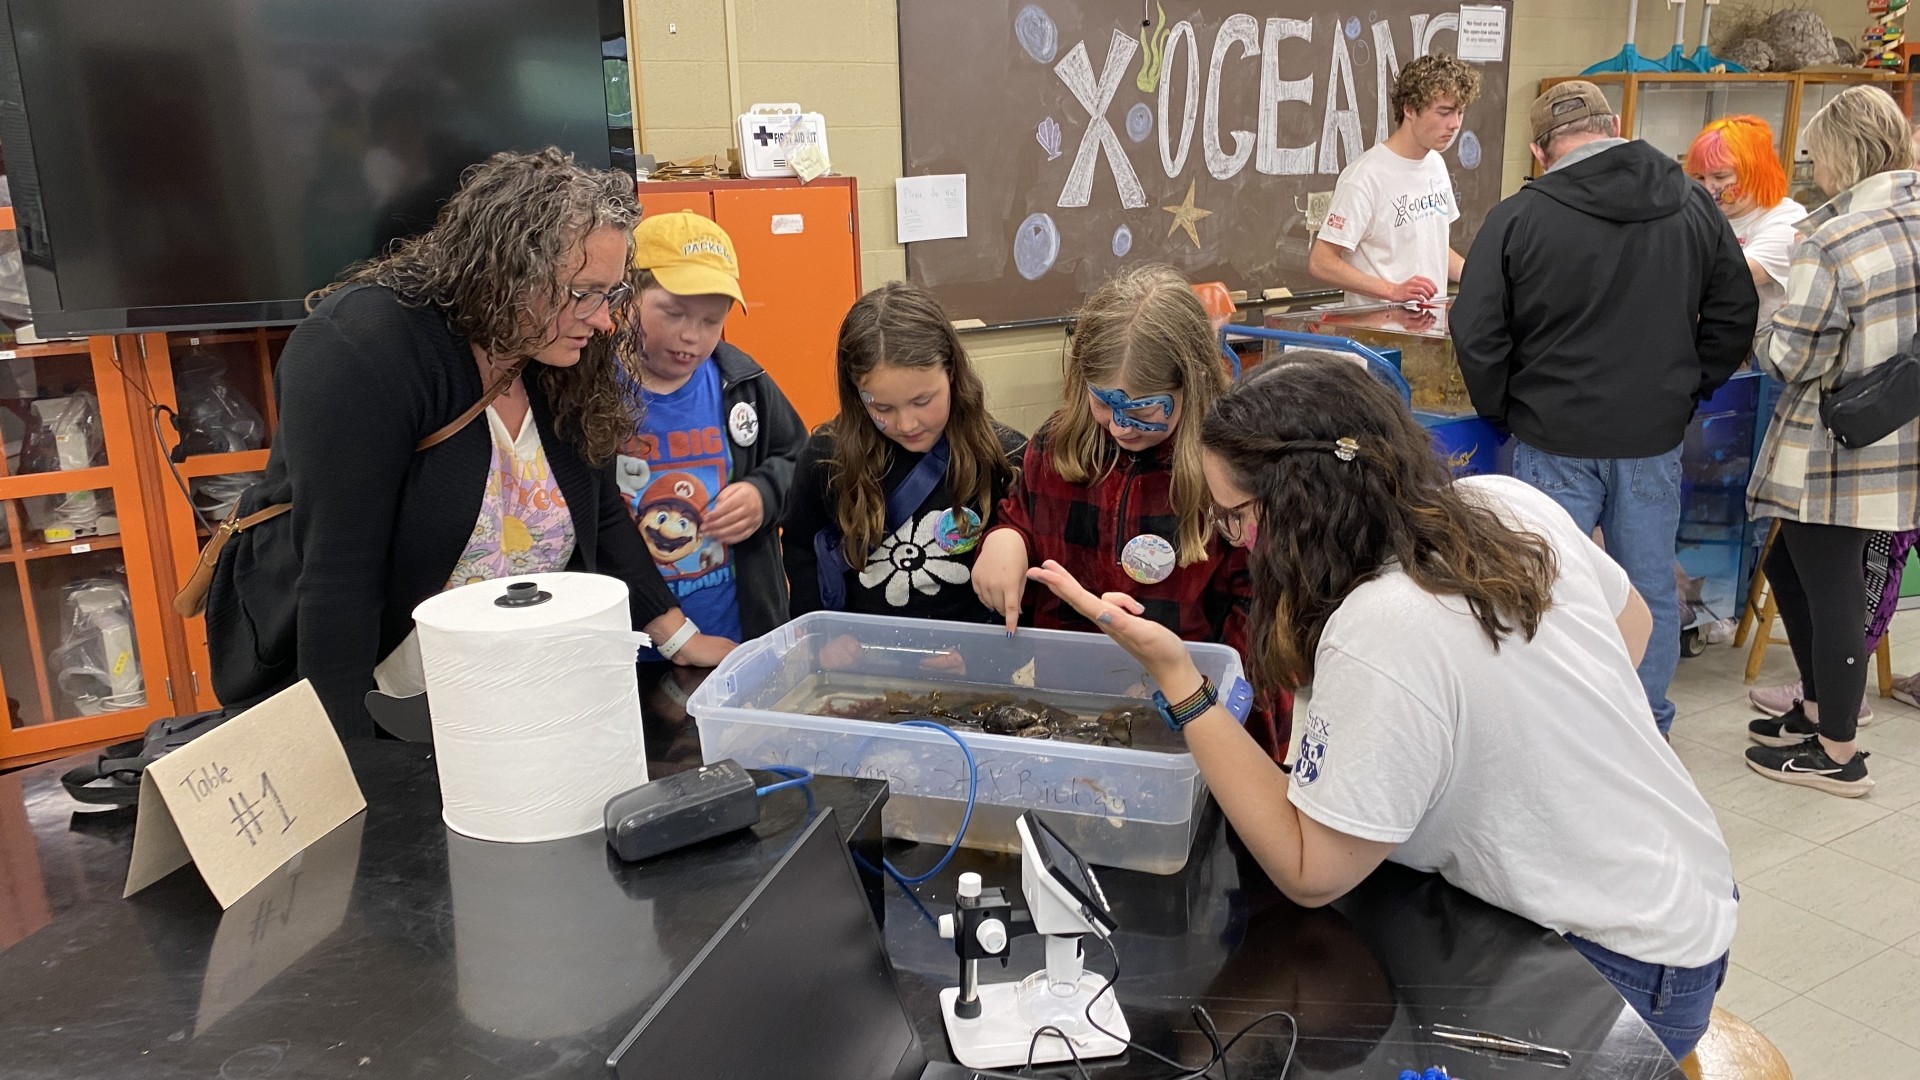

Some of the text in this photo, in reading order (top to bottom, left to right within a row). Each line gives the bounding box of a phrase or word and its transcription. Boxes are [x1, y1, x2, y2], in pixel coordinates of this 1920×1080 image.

[774, 132, 793, 144] FIRST
[794, 132, 805, 143] AID
[1053, 28, 1148, 209] X
[667, 426, 722, 458] BIG
[178, 761, 234, 803] Table
[228, 771, 298, 847] #1
